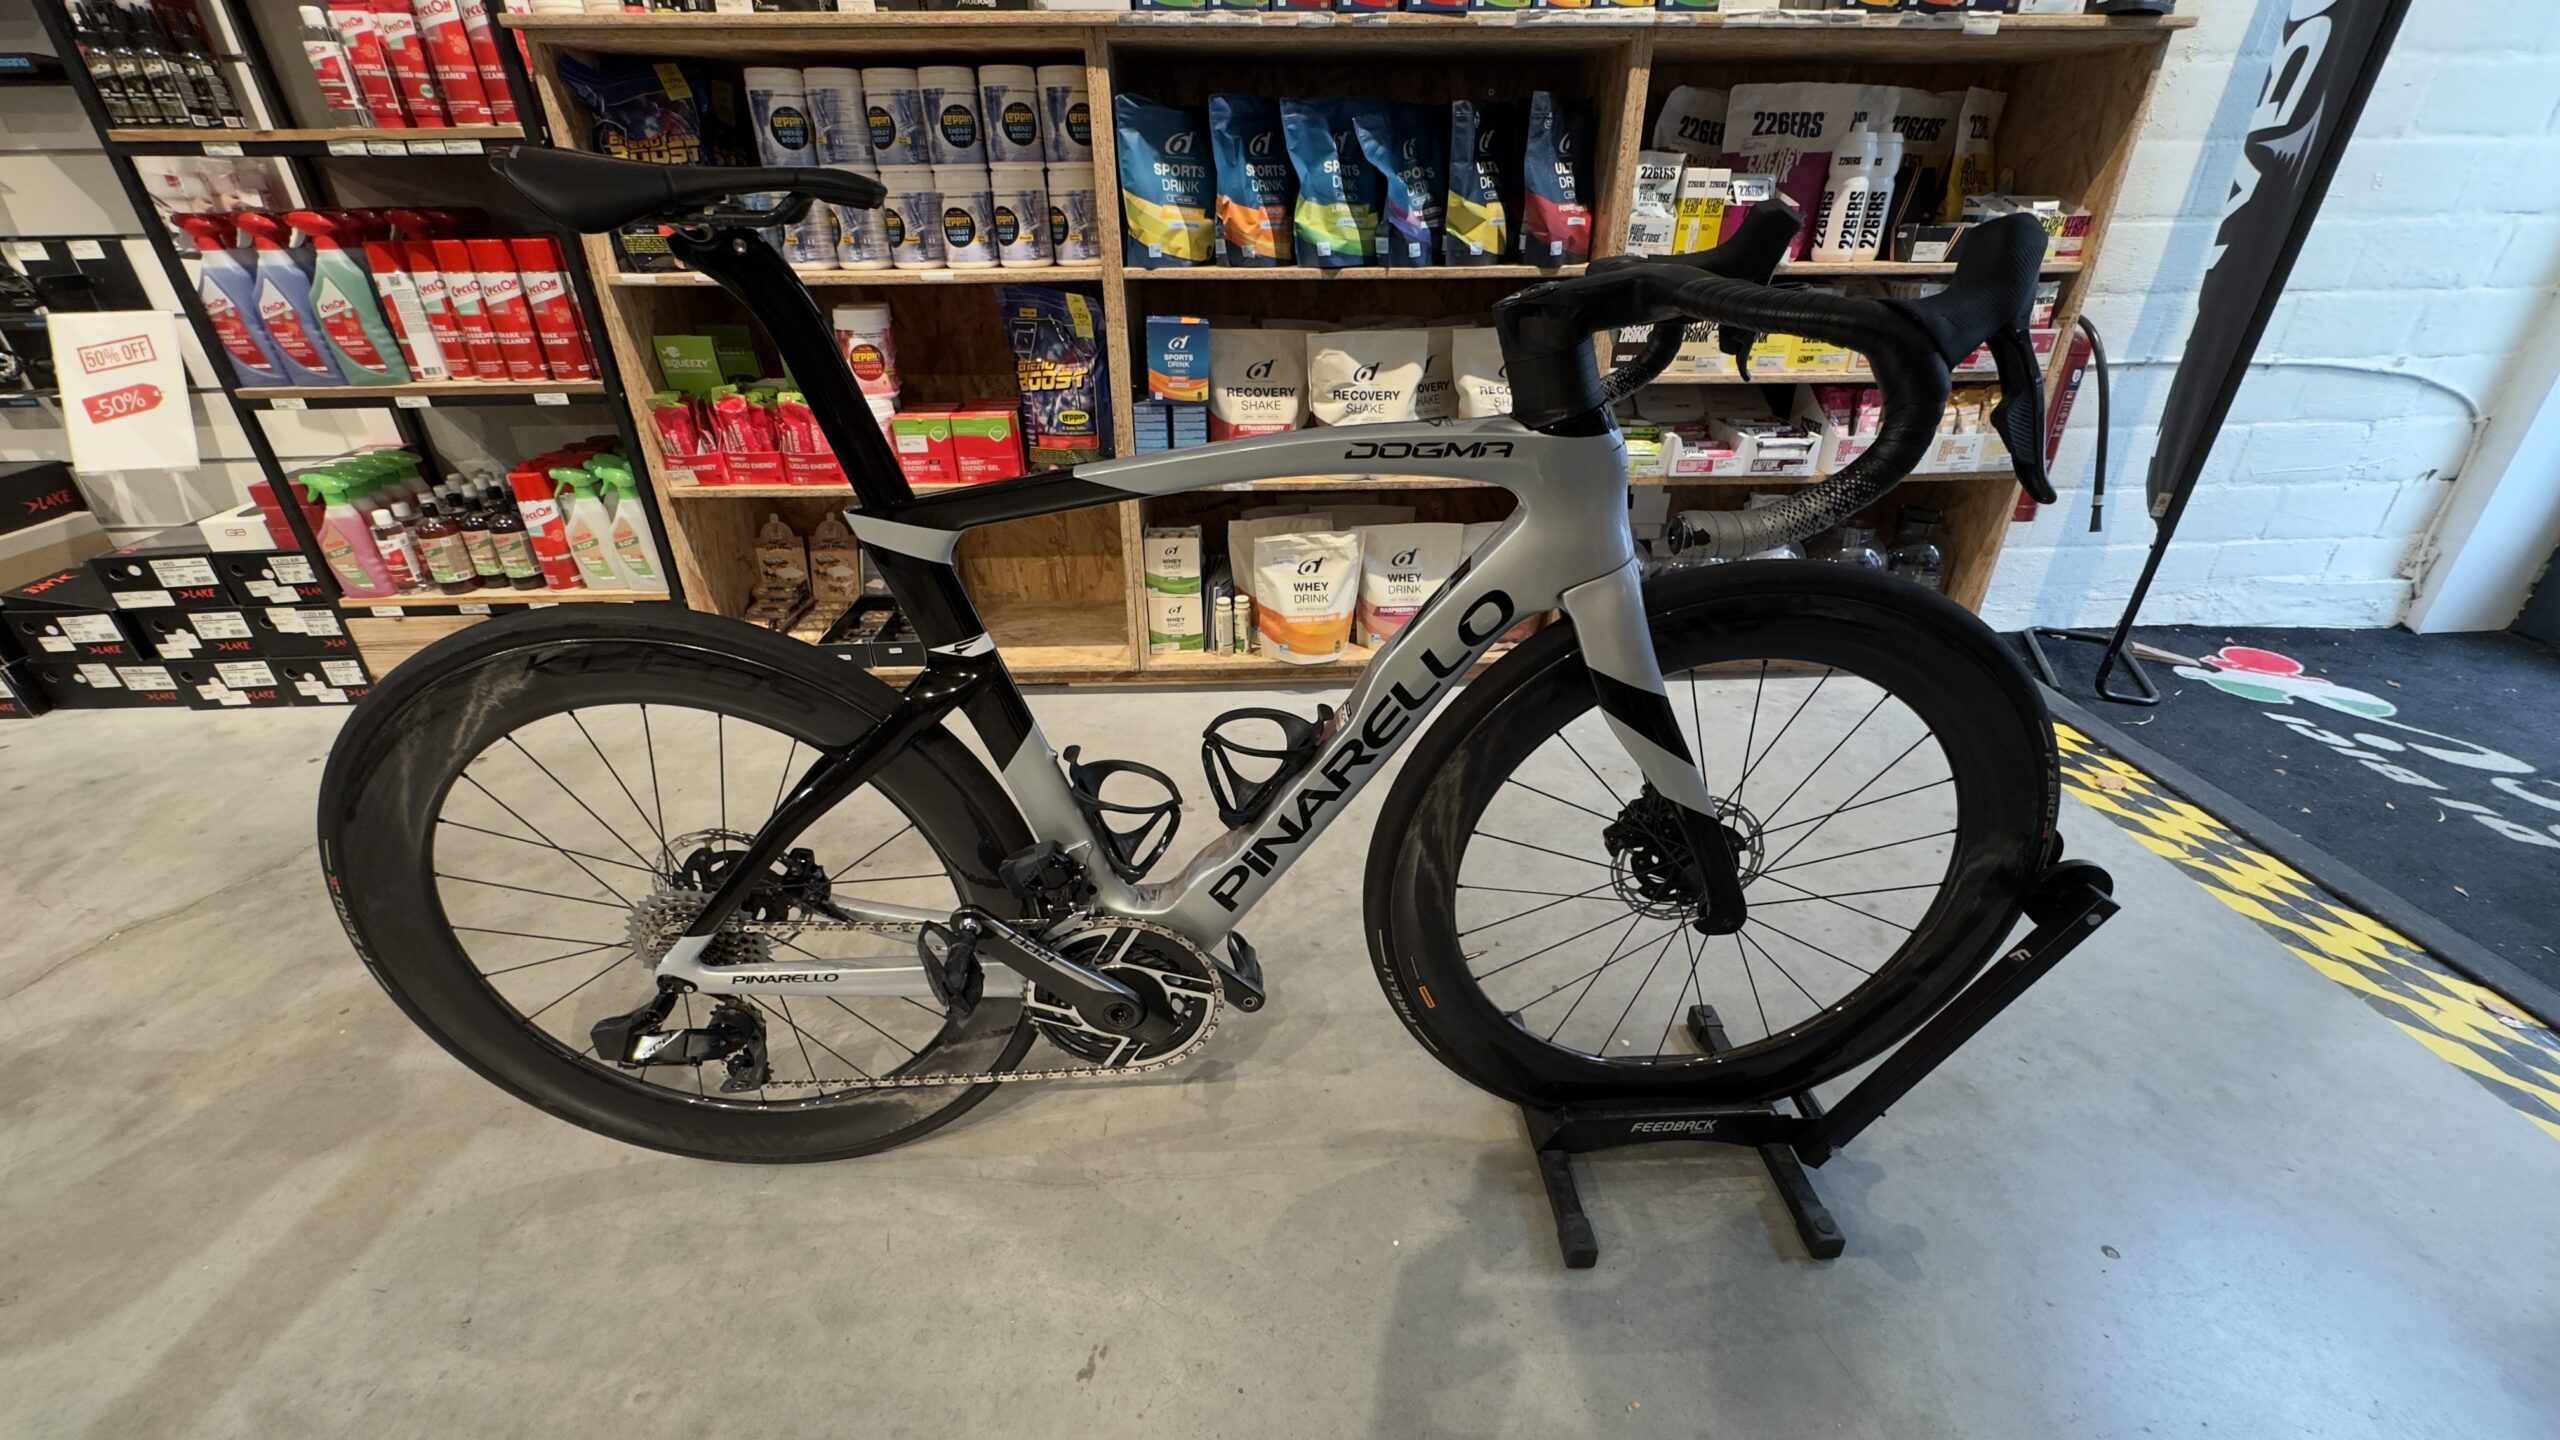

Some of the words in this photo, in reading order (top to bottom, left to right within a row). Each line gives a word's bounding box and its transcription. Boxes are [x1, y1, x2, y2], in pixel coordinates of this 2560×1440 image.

[1752, 111, 1825, 138] 226ERS
[1154, 162, 1205, 178] SPORTS
[1246, 163, 1286, 177] SPORTS
[1641, 166, 1676, 180] 226ERS
[1162, 179, 1200, 193] DRINK
[1252, 179, 1285, 192] DRINK
[1838, 191, 1865, 249] 226ERS
[1859, 191, 1887, 249] 226ERS
[1628, 233, 1661, 244] FRUCTOSE
[419, 279, 446, 295] CYCLO
[452, 280, 480, 297] CYCLO
[84, 347, 121, 368] 50%
[121, 341, 147, 361] OFF
[853, 352, 880, 361] Leppin
[664, 359, 708, 368] SQUEEZY
[1018, 367, 1090, 392] BOOST
[1227, 386, 1296, 397] RECOVERY
[1418, 380, 1449, 394] OVERY
[1480, 386, 1511, 396] RECO
[1333, 389, 1401, 401] RECOVERY
[1417, 394, 1441, 406] HAKE
[93, 389, 146, 418] -50%
[1241, 400, 1281, 411] SHAKE
[1346, 403, 1385, 415] SHAKE
[1062, 412, 1086, 423] Leppin
[1344, 441, 1514, 459] DOGMA
[750, 461, 777, 469] ENERGY
[37, 489, 72, 510] LAKE
[1388, 573, 1422, 583] WHEY
[1293, 582, 1329, 592] WHEY
[1388, 584, 1422, 594] DRINK
[188, 588, 216, 599] LAKE
[1294, 594, 1329, 605] DRINK
[98, 645, 122, 655] LAKE
[226, 641, 250, 650] LAKE
[154, 692, 177, 700] LAKE
[254, 689, 276, 699] LAKE
[0, 703, 16, 712] AKE
[1208, 589, 1515, 912] PINARELLO
[731, 973, 840, 985] PINARELLO
[1384, 966, 1418, 1024] PIRELLI
[1630, 1119, 1718, 1133] FEEDBACK
